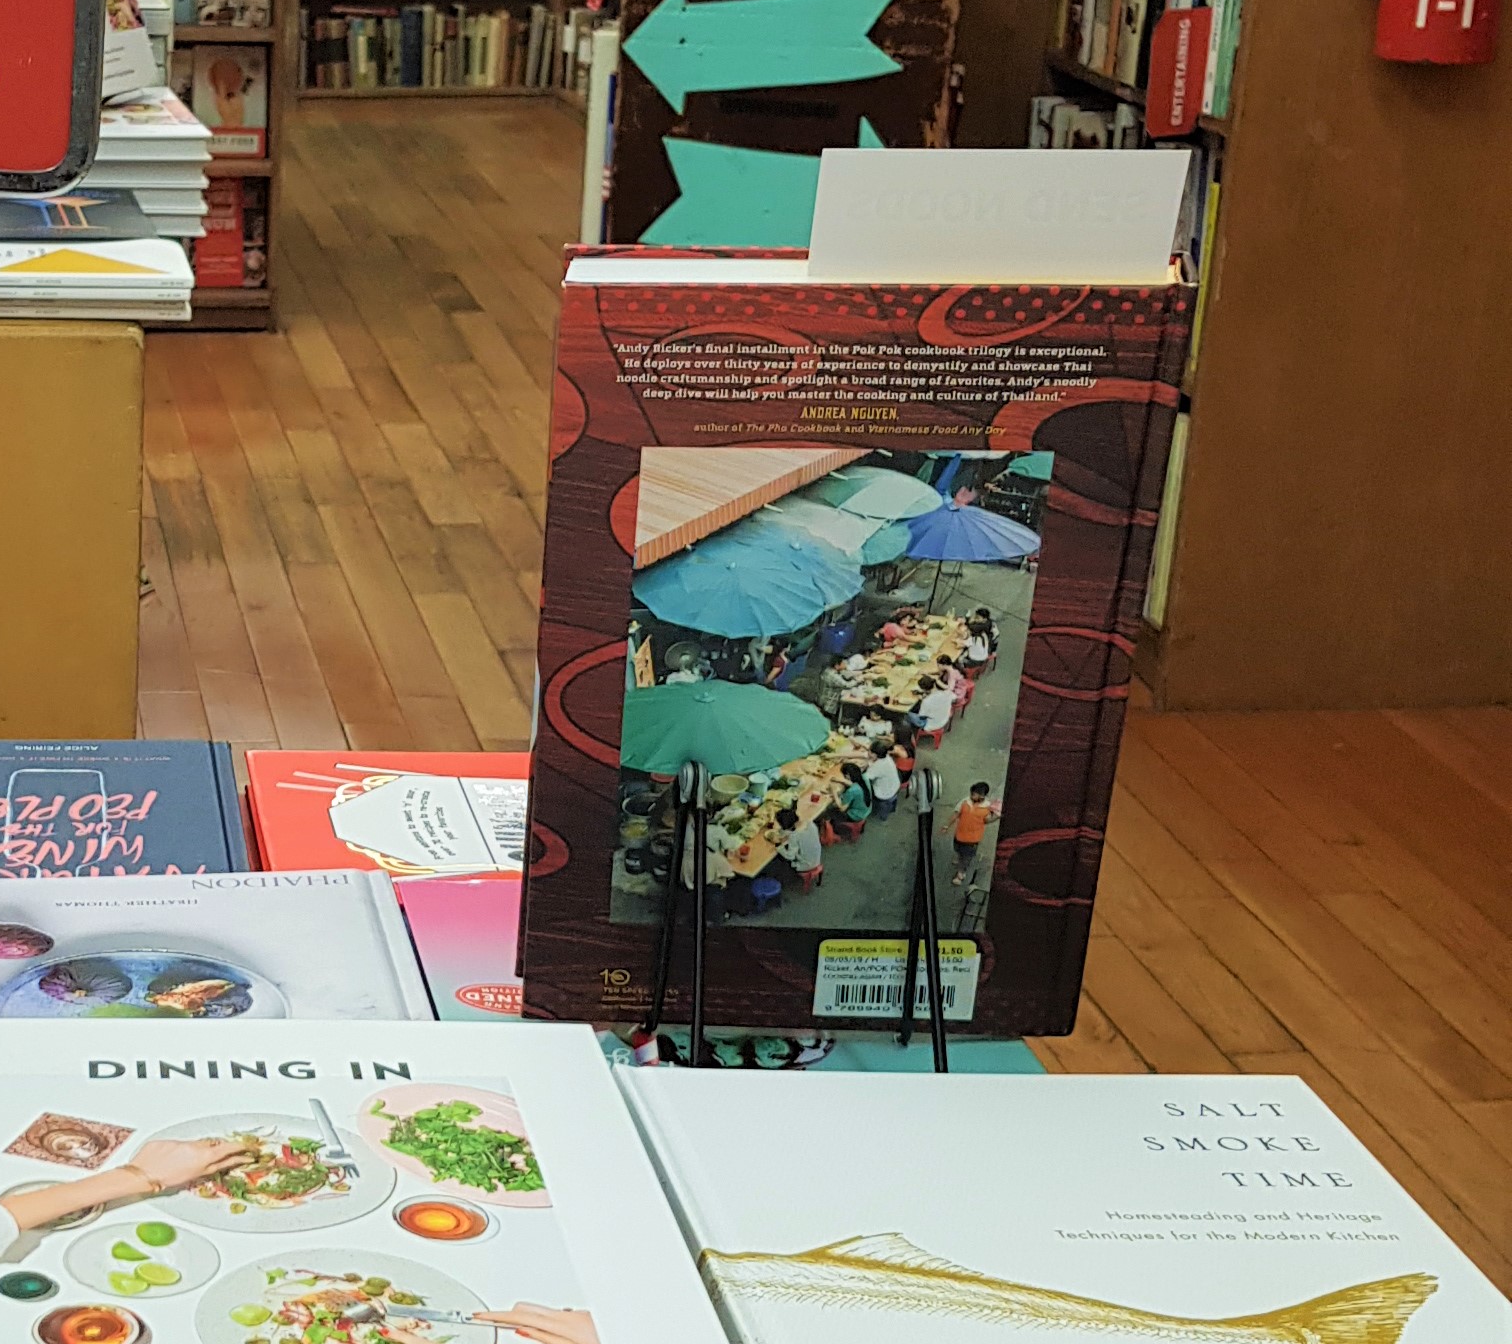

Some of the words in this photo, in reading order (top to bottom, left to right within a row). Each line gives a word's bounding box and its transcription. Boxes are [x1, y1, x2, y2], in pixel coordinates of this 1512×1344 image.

[1170, 18, 1191, 126] ENTERTAINING
[705, 344, 733, 354] final
[737, 344, 809, 354] installment
[813, 345, 825, 354] in
[829, 345, 849, 355] the
[853, 346, 875, 355] Pok
[879, 346, 901, 355] Pok
[905, 346, 967, 356] cookbook
[968, 346, 1011, 357] trilogy
[1015, 347, 1026, 356] is
[624, 359, 639, 368] He
[644, 359, 690, 370] deploys
[695, 360, 720, 369] over
[724, 360, 760, 371] thirty
[764, 361, 798, 371] years
[801, 360, 814, 369] of
[817, 361, 885, 372] experience
[888, 362, 901, 370] to
[904, 361, 968, 372] demystify
[971, 362, 994, 371] and
[999, 362, 1060, 371] showcase
[1063, 362, 1092, 371] Thai
[616, 374, 657, 383] noodle
[660, 374, 751, 385] craftsmanship
[755, 374, 777, 383] and
[782, 374, 838, 386] spotlight
[852, 376, 886, 385] broad
[890, 378, 925, 387] range
[929, 376, 943, 386] of
[643, 389, 672, 400] deep
[675, 389, 701, 398] dive
[705, 389, 728, 398] will
[732, 389, 758, 400] help
[762, 391, 784, 401] you
[788, 391, 830, 399] master
[835, 390, 853, 399] the
[857, 390, 906, 401] cooking
[910, 391, 933, 400] and
[937, 391, 982, 401] culture
[985, 391, 999, 401] of
[801, 406, 845, 419] ANDREA
[694, 423, 729, 432] author
[732, 423, 743, 433] of
[746, 423, 764, 432] The
[845, 424, 865, 433] and
[71, 820, 127, 836] FOR
[192, 874, 349, 889] PHAIDON
[88, 1060, 316, 1080] DINING
[350, 1061, 412, 1081] IN
[1163, 1103, 1283, 1117] SALT
[1143, 1136, 1321, 1152] SMOKE
[1221, 1172, 1353, 1188] TIME
[1104, 1210, 1247, 1223] Homesteading
[1253, 1211, 1291, 1221] and
[1295, 1211, 1382, 1224] Heritage
[1054, 1229, 1165, 1242] Techniques
[1169, 1230, 1198, 1241] for
[1205, 1230, 1237, 1241] the
[1243, 1230, 1321, 1241] Modern
[1325, 1231, 1400, 1241] Kitchen
